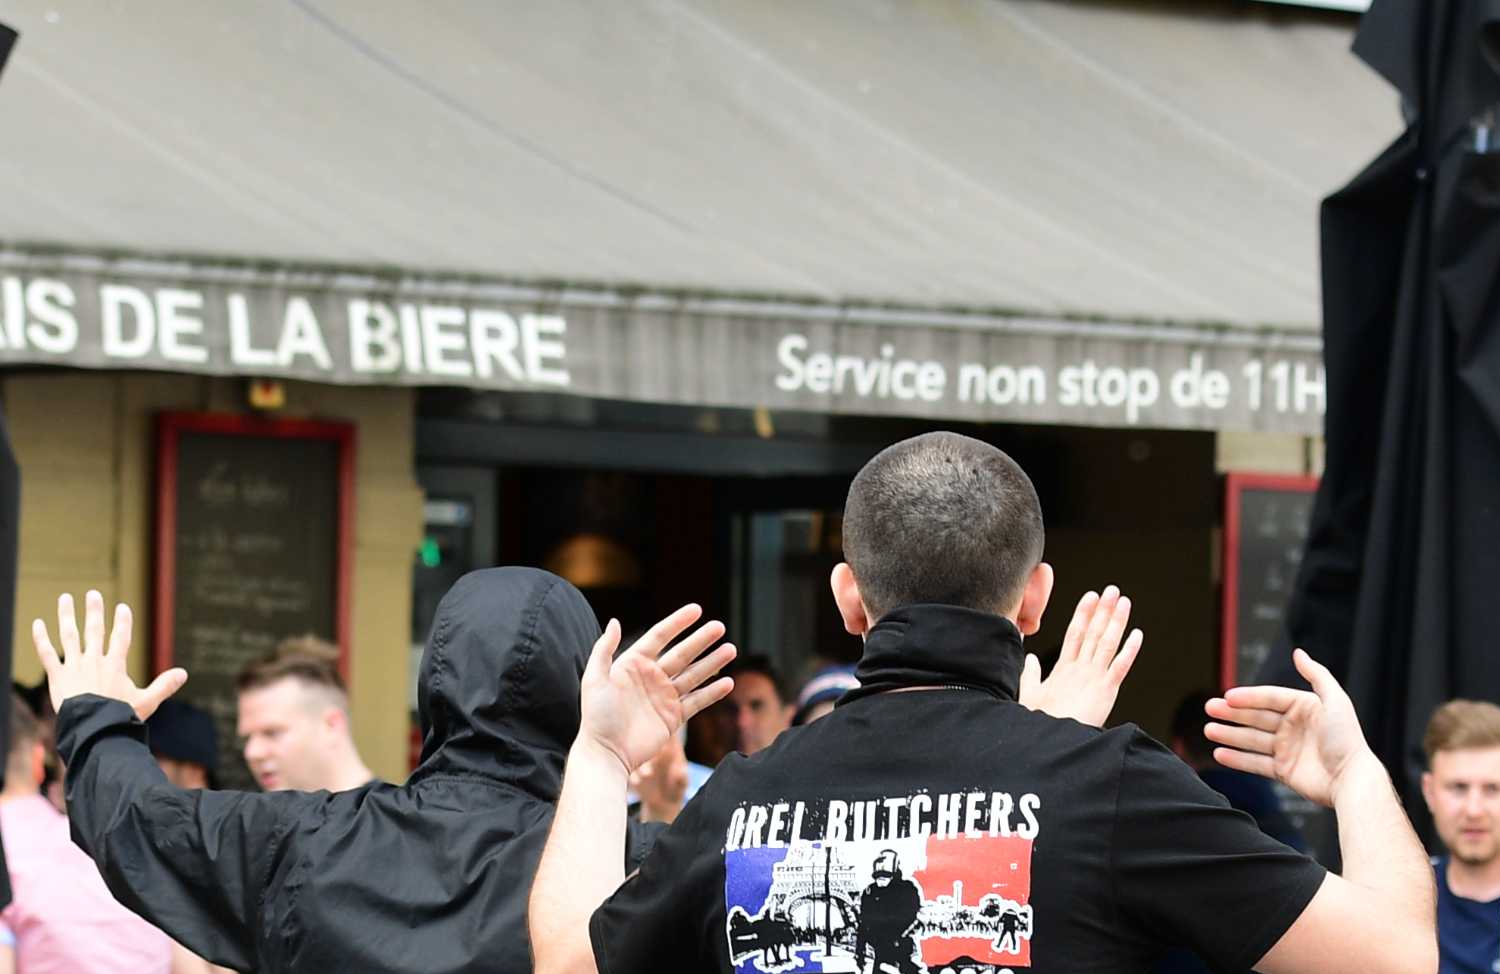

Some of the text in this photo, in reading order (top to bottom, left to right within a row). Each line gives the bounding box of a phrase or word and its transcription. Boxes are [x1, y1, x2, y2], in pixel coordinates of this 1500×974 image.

[0, 277, 571, 386] IS DE LA BIERE
[775, 333, 1327, 424] Service non stop de 11H
[824, 792, 1041, 848] BUTCHERS
